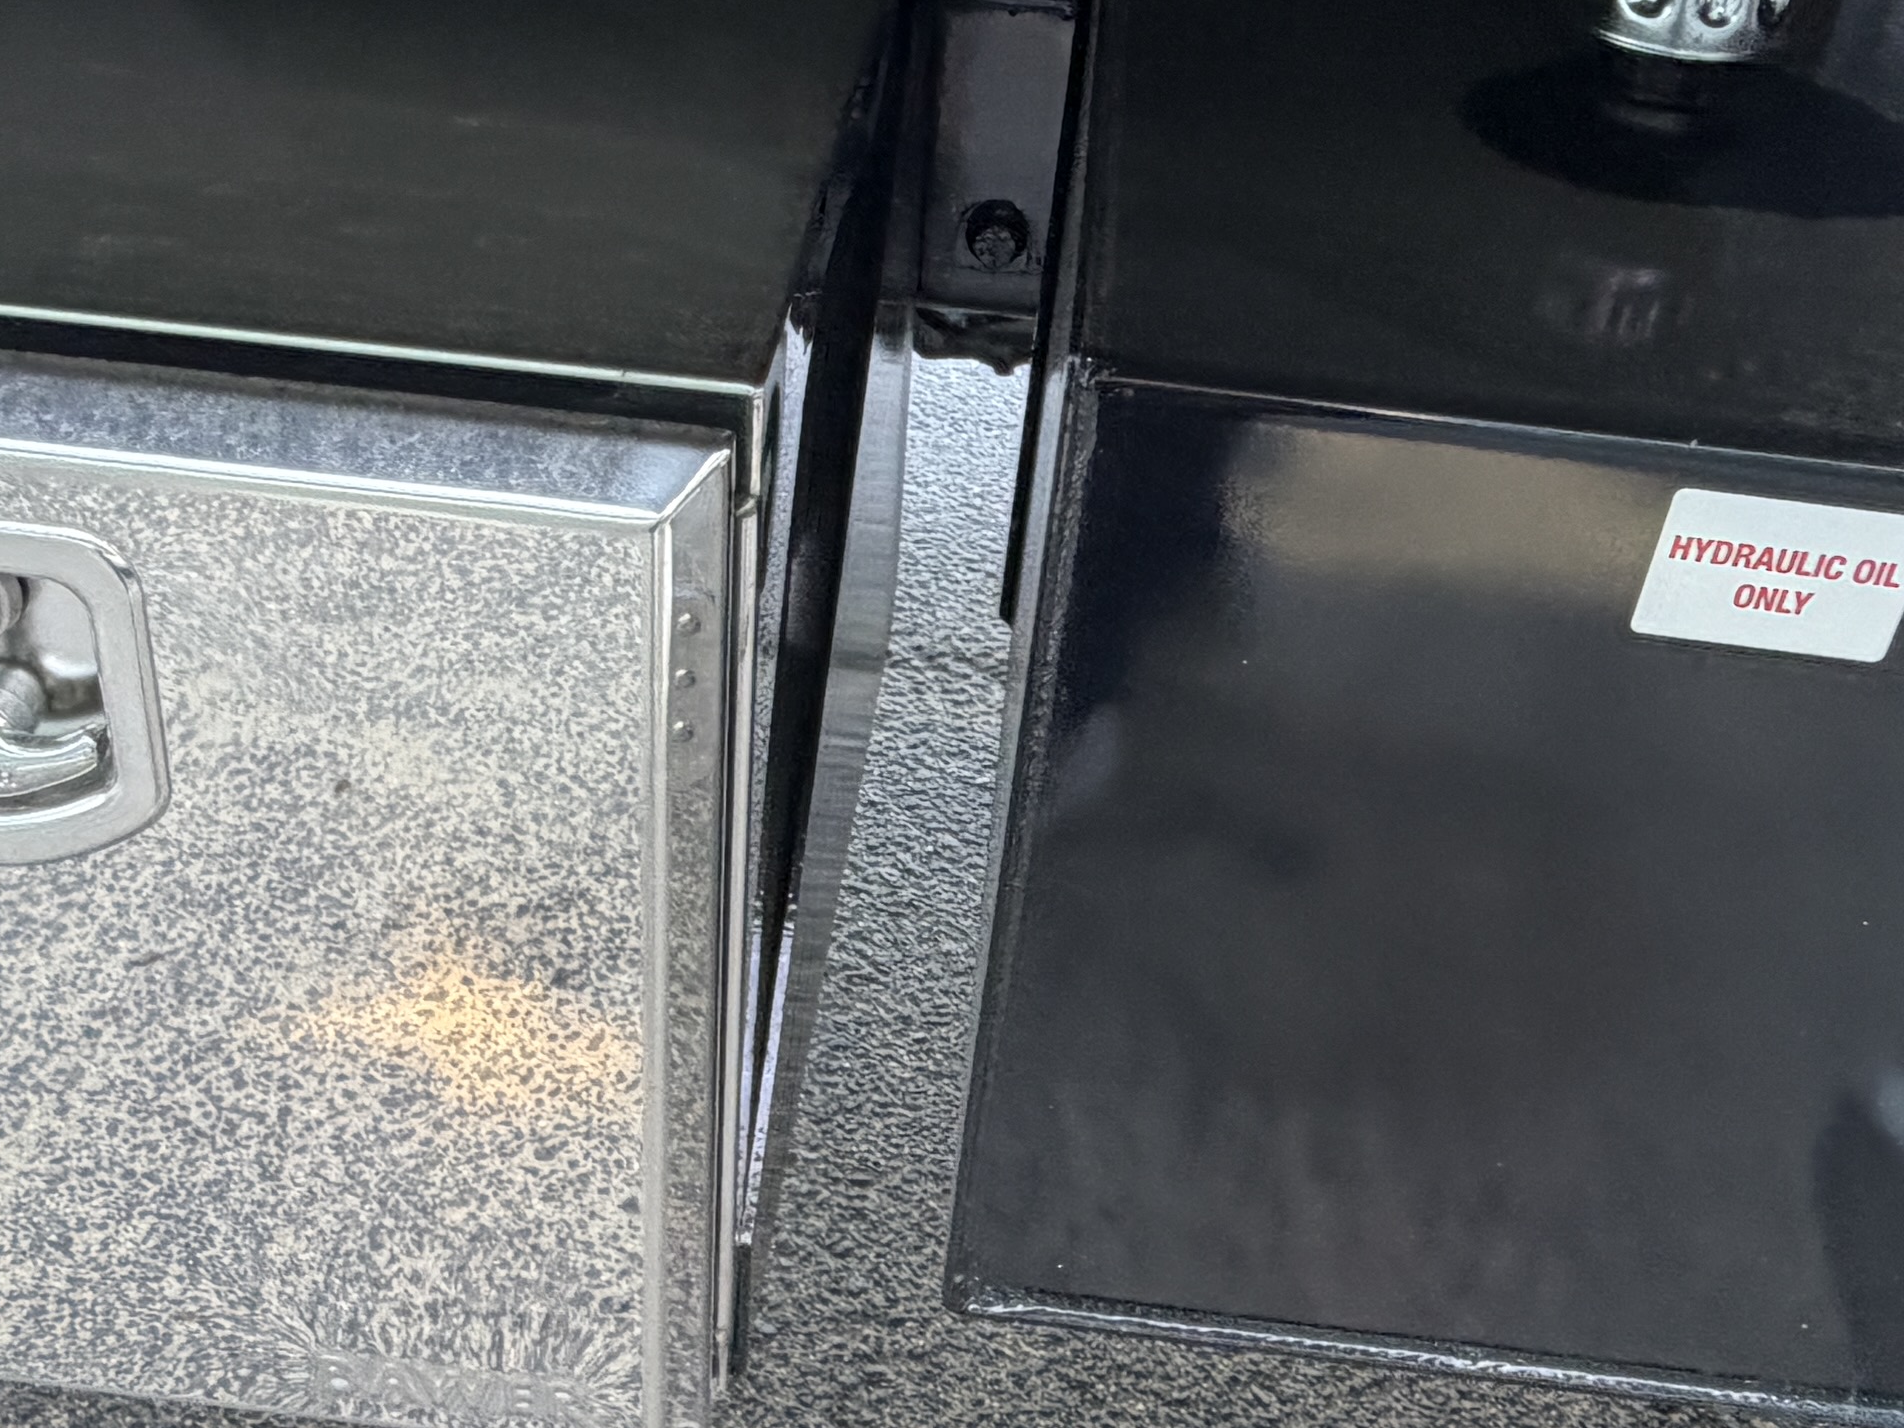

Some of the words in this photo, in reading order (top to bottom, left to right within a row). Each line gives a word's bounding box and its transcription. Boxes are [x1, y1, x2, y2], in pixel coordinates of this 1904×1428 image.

[1668, 535, 1848, 581] HYDRAULIC
[1852, 559, 1901, 589] OIL
[1732, 584, 1815, 616] ONLY
